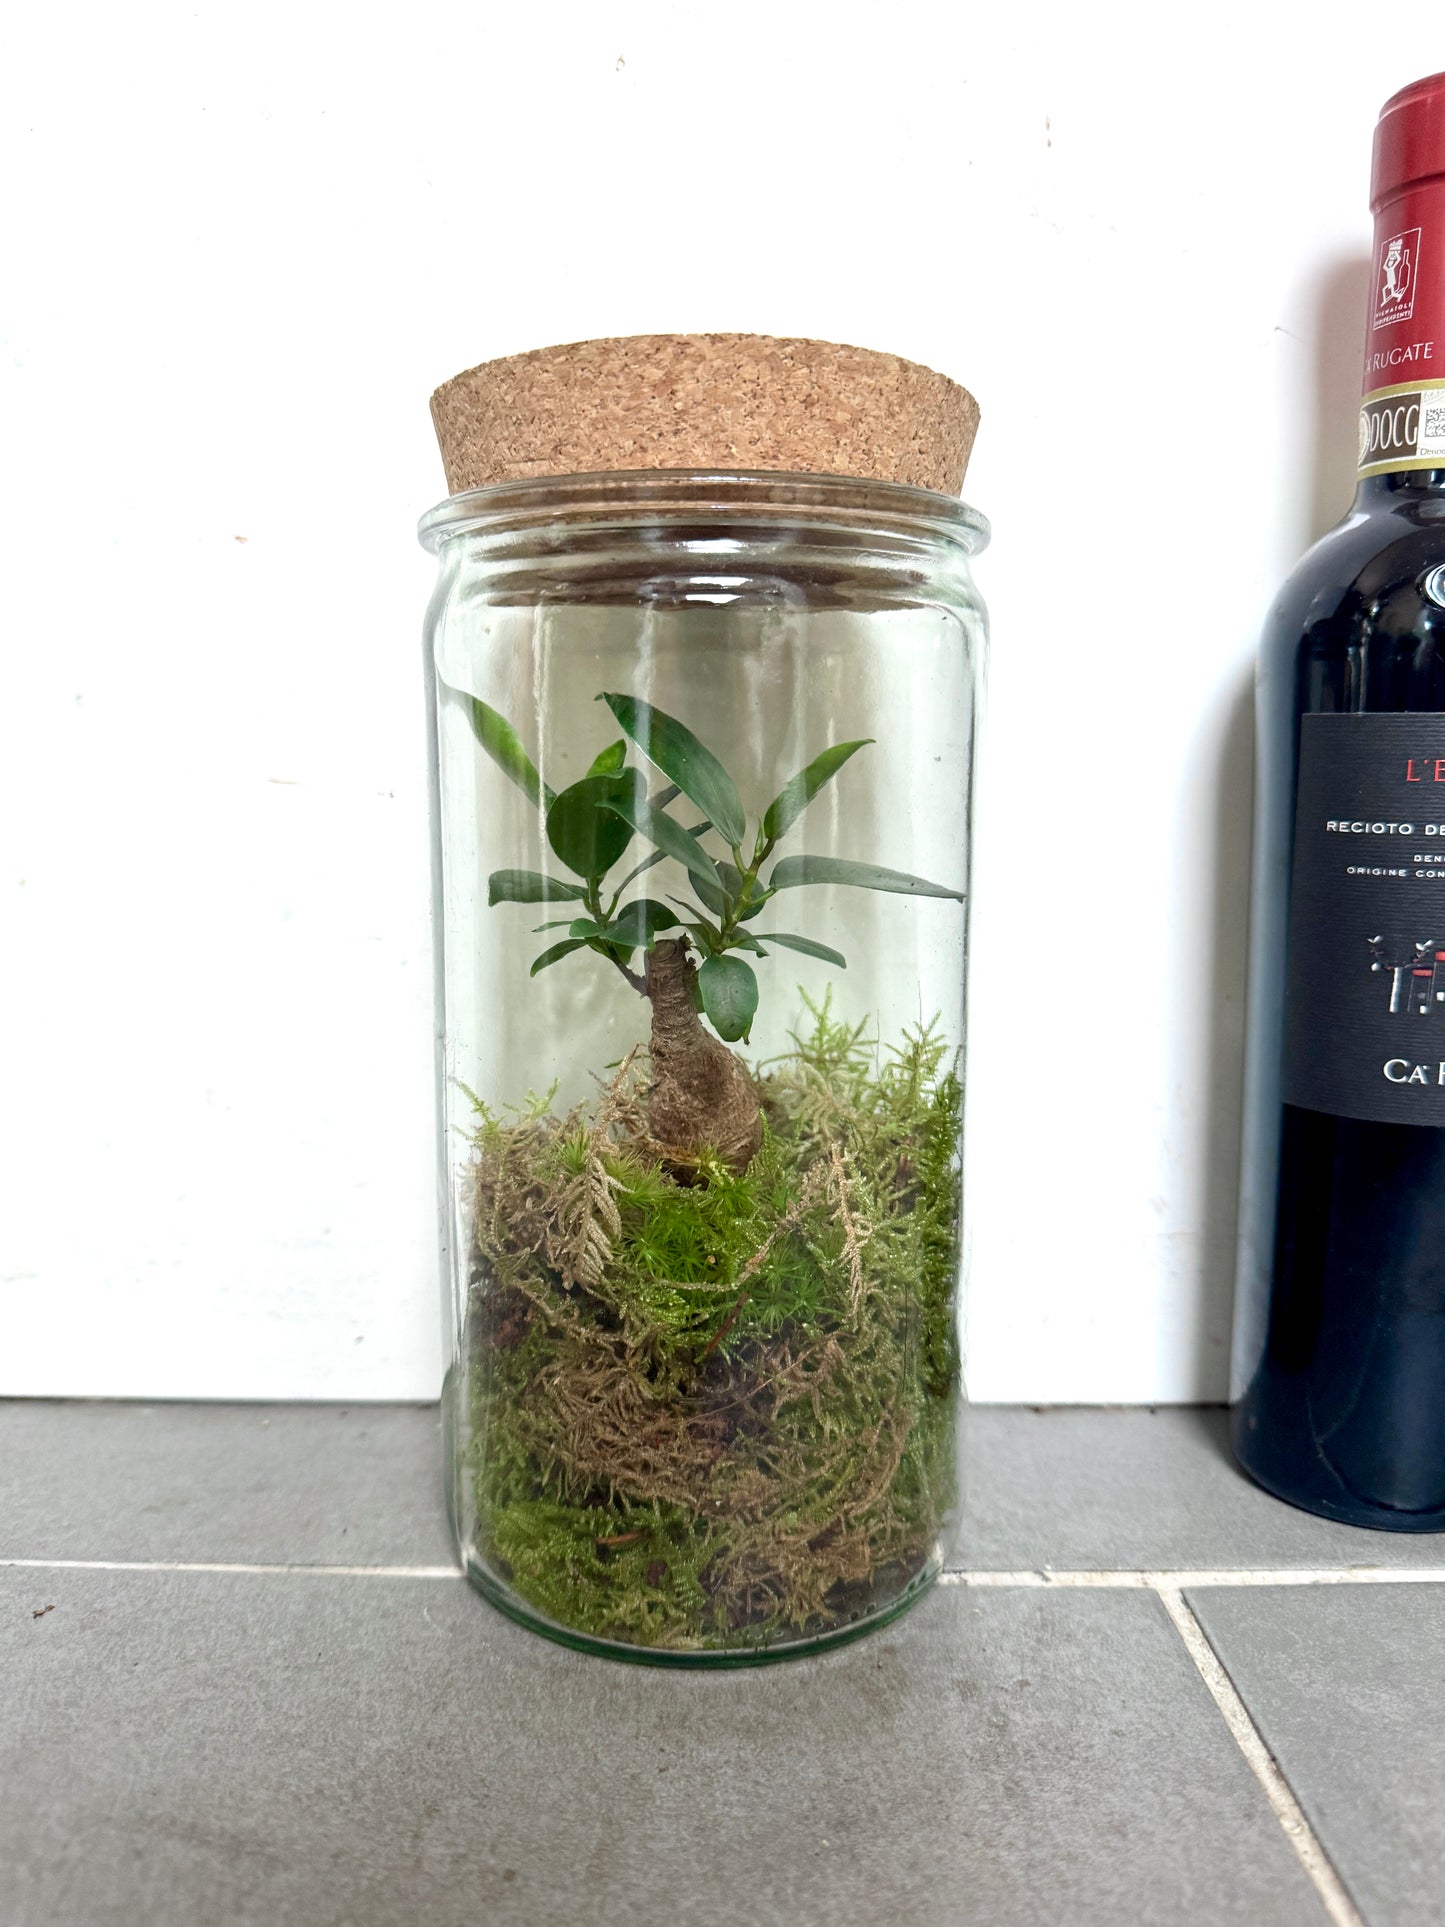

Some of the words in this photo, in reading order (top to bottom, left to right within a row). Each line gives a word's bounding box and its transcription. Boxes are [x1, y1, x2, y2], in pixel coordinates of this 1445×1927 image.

[1369, 404, 1420, 452] DOCG
[1406, 759, 1445, 782] L'E
[1326, 821, 1413, 835] RECIOTO
[1413, 854, 1445, 863] DEN
[1346, 866, 1407, 877] ORIGINE
[1415, 870, 1445, 878] CON
